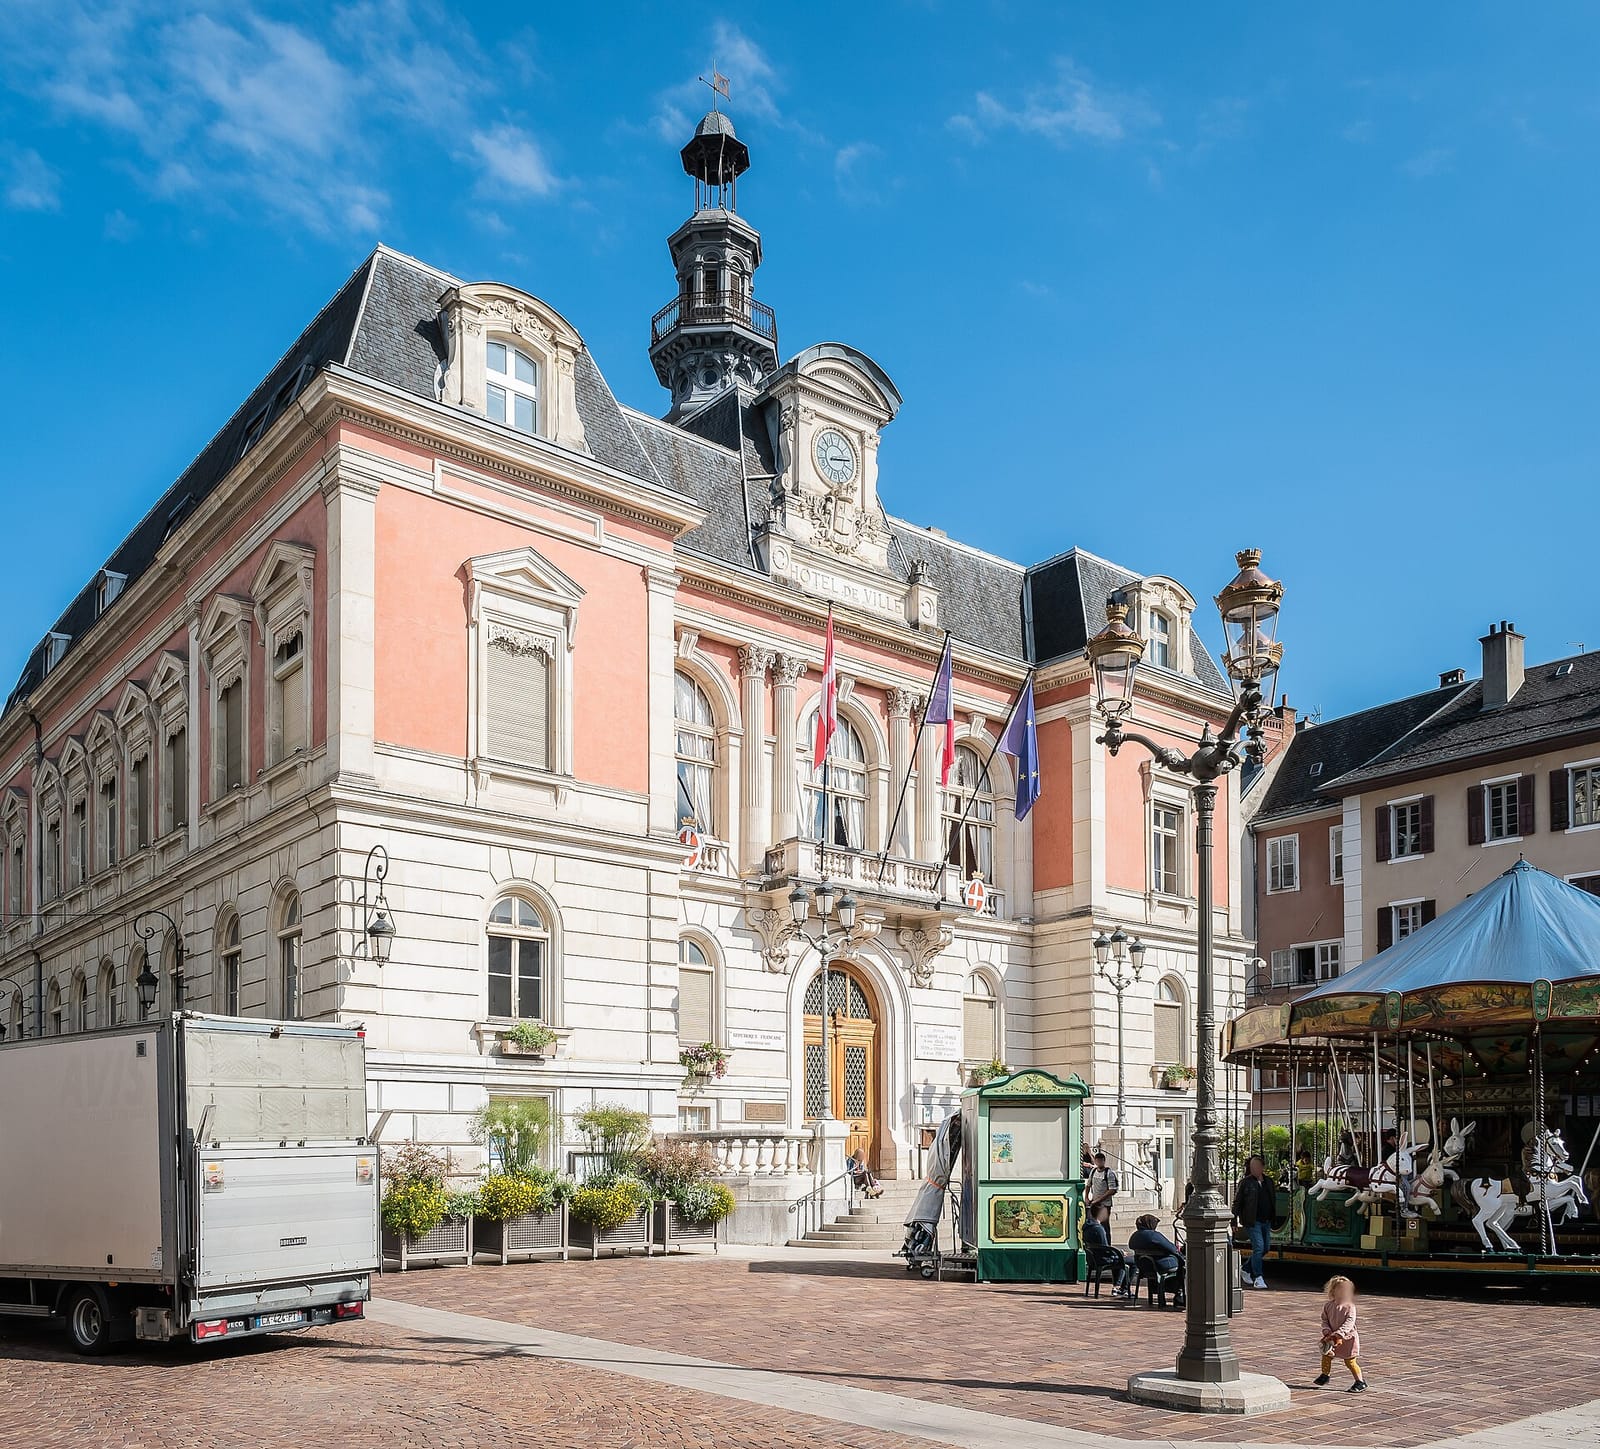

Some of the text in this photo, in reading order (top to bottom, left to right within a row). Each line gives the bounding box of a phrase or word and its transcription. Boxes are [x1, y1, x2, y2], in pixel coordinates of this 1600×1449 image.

[843, 585, 859, 602] DE
[863, 588, 904, 614] VILLE
[226, 1320, 244, 1329] VECO
